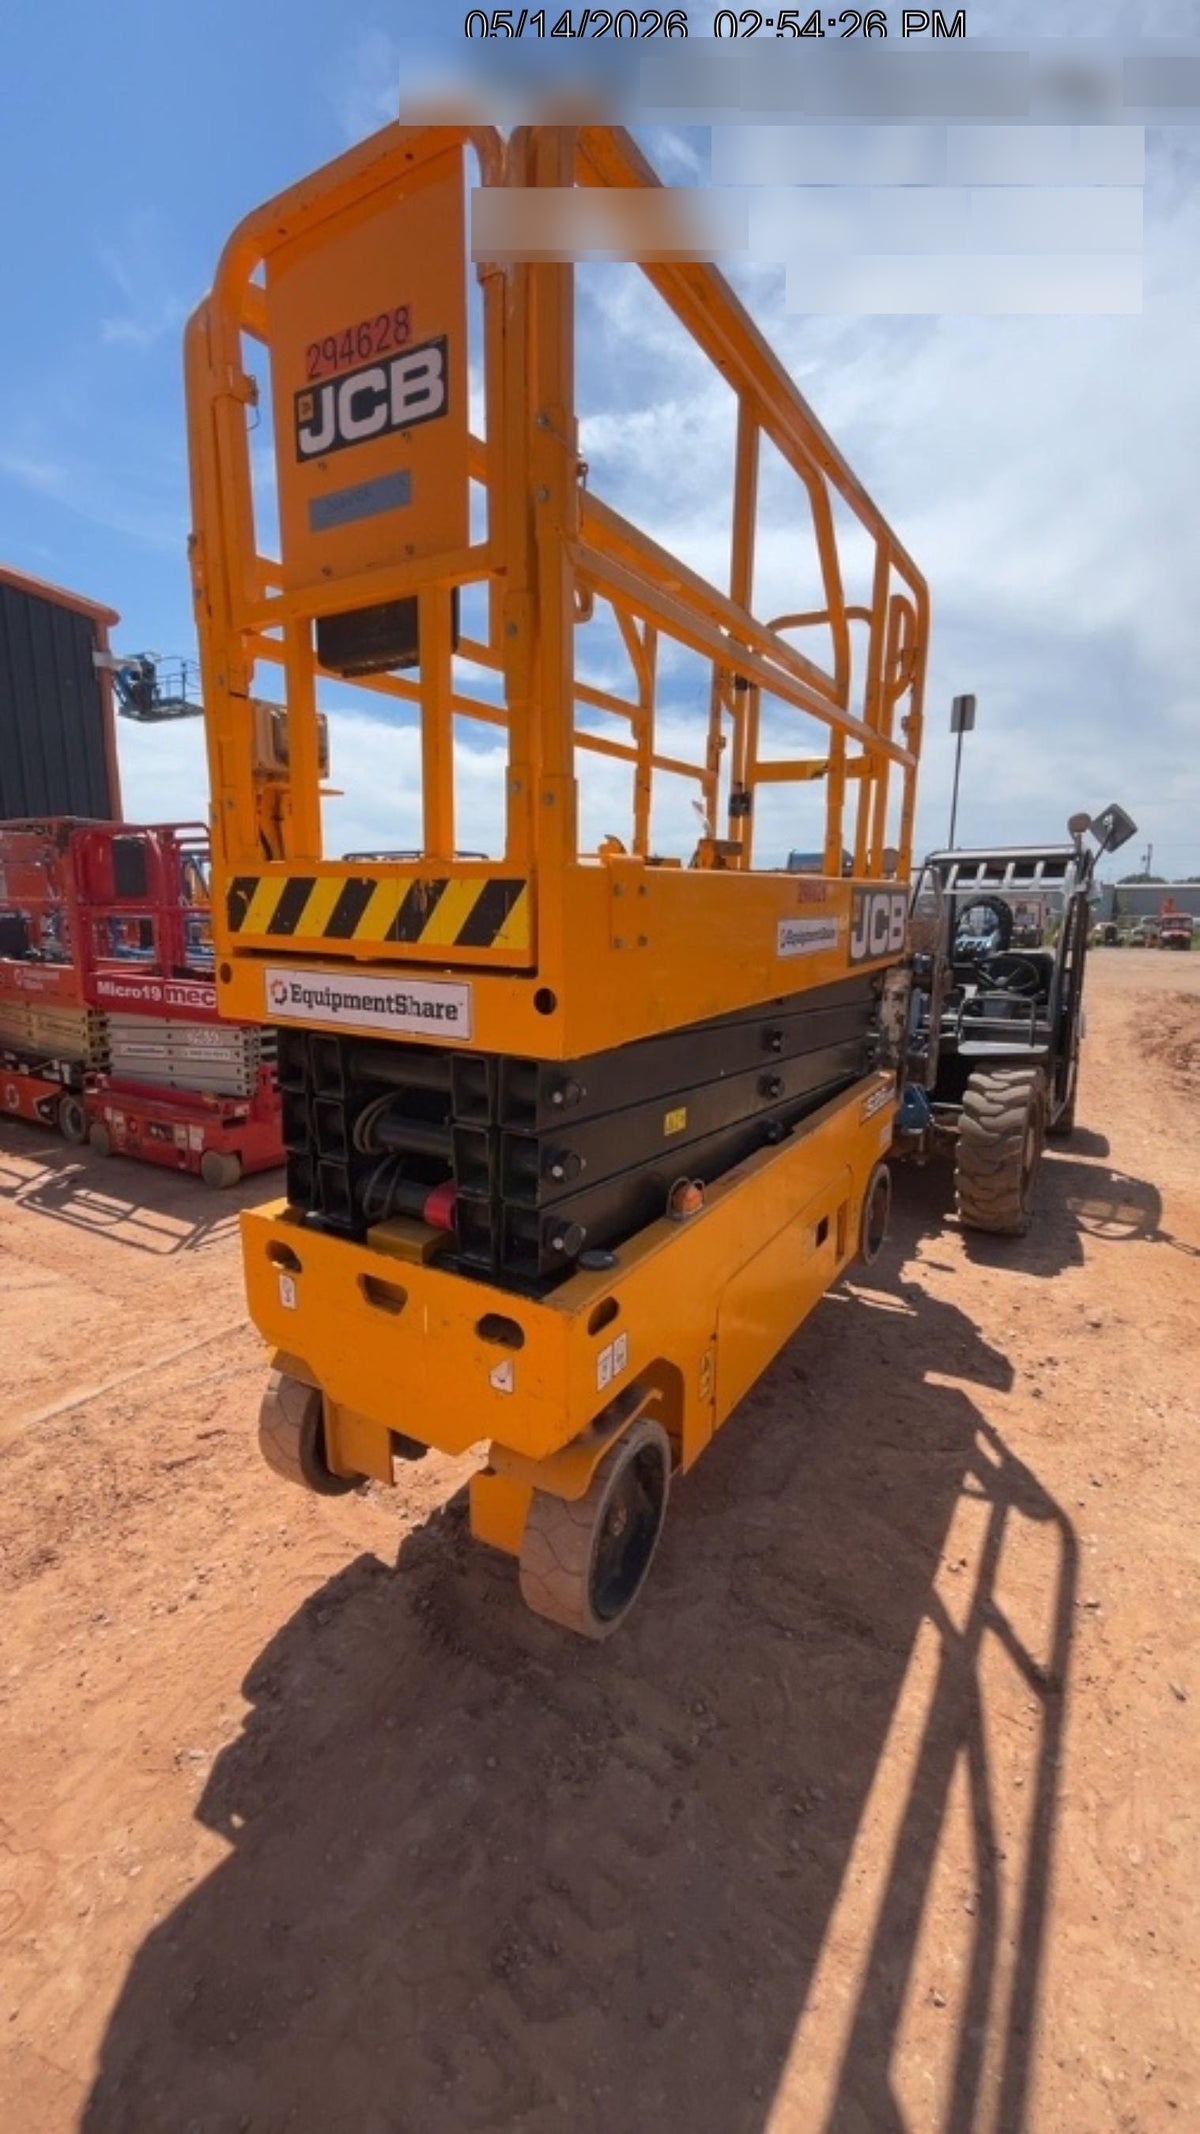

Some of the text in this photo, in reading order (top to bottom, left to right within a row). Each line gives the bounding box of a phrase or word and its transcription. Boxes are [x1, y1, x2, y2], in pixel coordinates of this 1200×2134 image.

[307, 305, 409, 379] 294628
[299, 347, 445, 454] JCB
[851, 893, 906, 959] JCB
[97, 981, 215, 1006] Micro19 mec
[290, 982, 459, 1020] EquipmentShare
